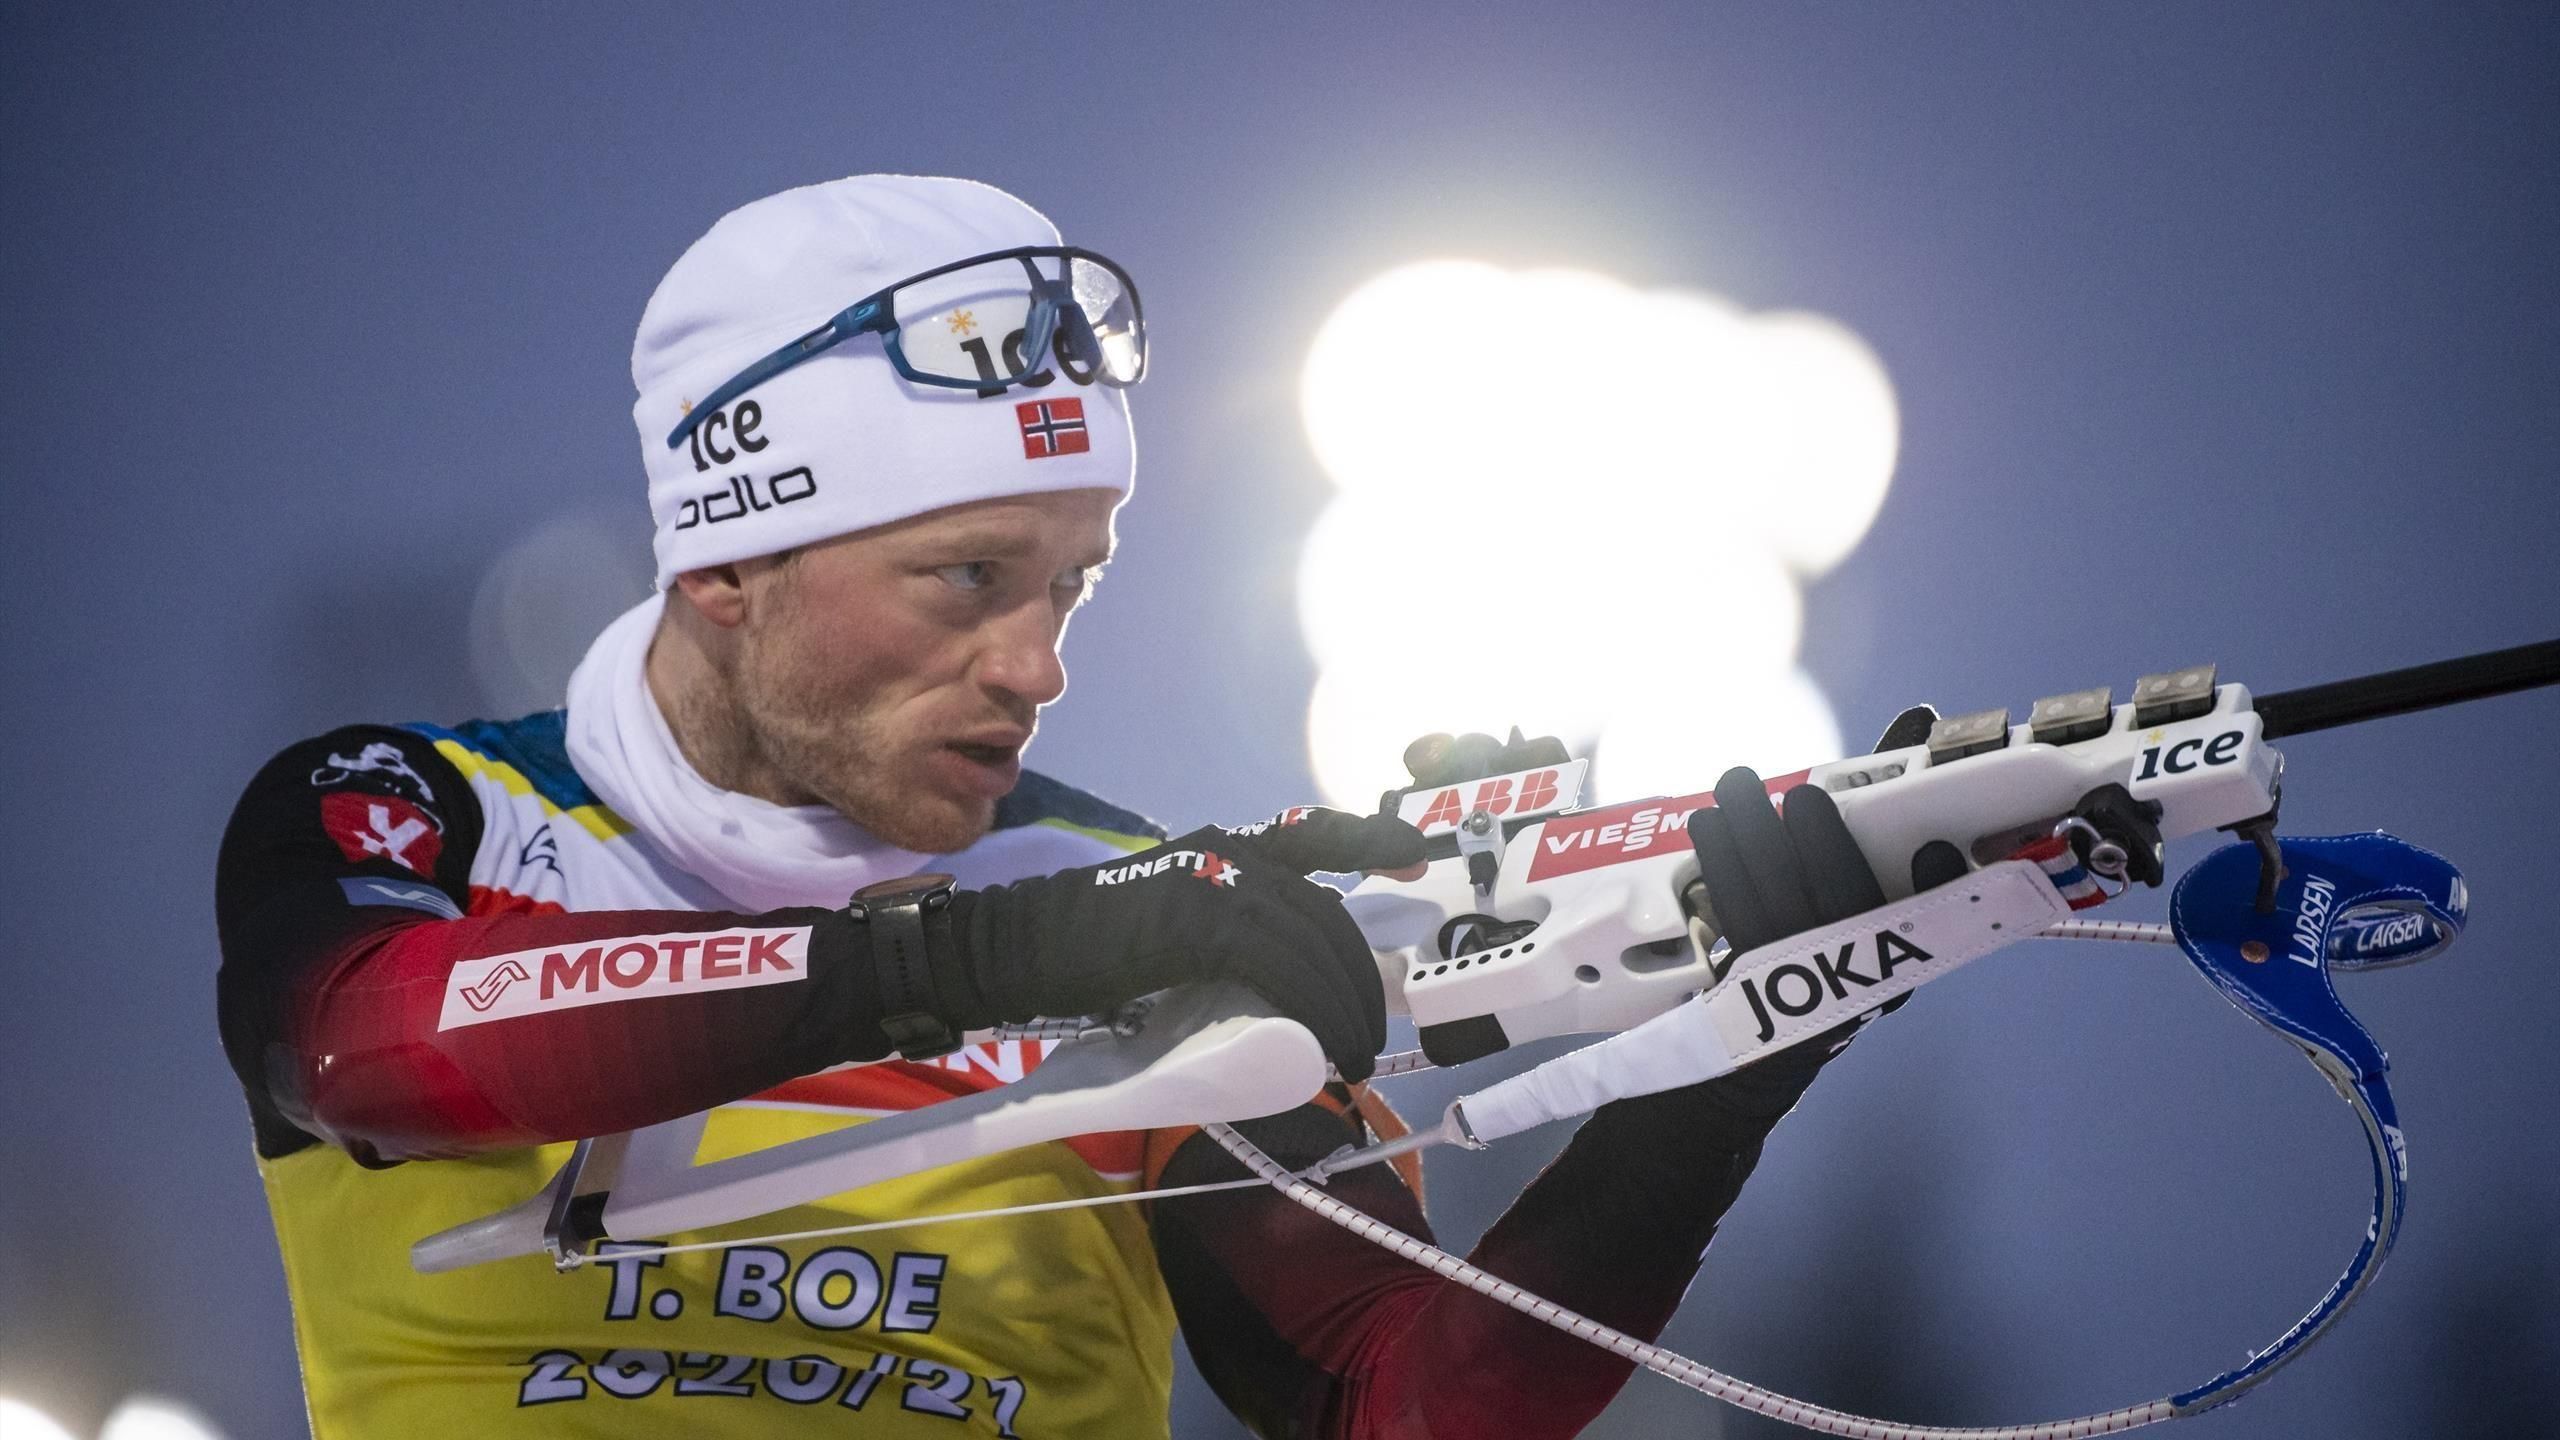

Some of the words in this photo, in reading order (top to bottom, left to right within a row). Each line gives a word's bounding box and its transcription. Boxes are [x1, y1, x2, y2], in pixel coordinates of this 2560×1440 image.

[680, 398, 770, 473] ice
[2136, 730, 2244, 782] ice
[1415, 770, 1559, 833] ABB
[2288, 873, 2336, 969] LARSEN
[2356, 913, 2425, 952] LARSEN
[540, 932, 798, 1001] MOTEK
[594, 1240, 684, 1321] T.
[713, 1245, 949, 1335] BOE
[516, 1348, 1027, 1440] 2020/21
